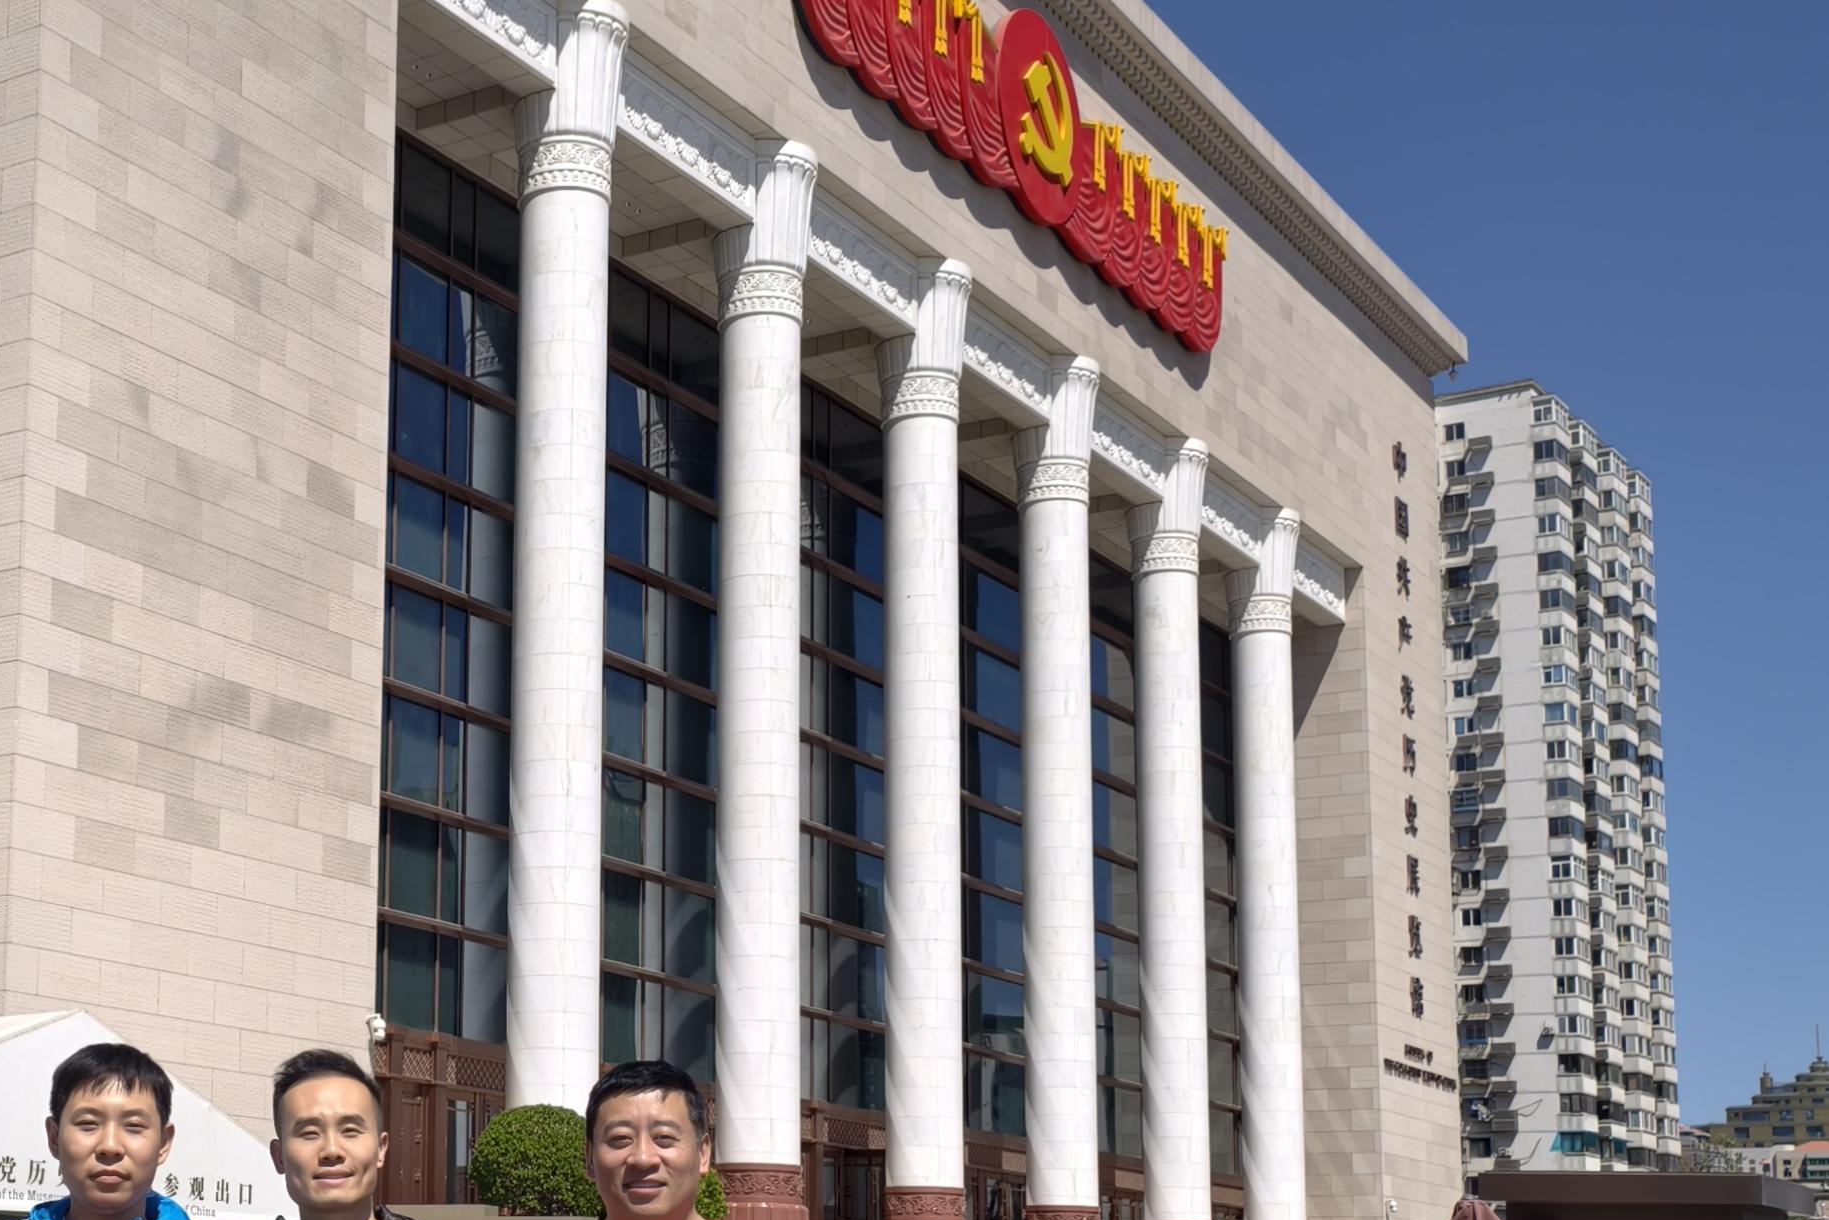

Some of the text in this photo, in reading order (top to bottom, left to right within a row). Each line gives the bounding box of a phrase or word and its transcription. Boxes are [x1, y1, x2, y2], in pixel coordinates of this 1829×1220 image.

[8, 1188, 25, 1201] the
[190, 1205, 216, 1217] China
[164, 1173, 253, 1205] 参观出口
